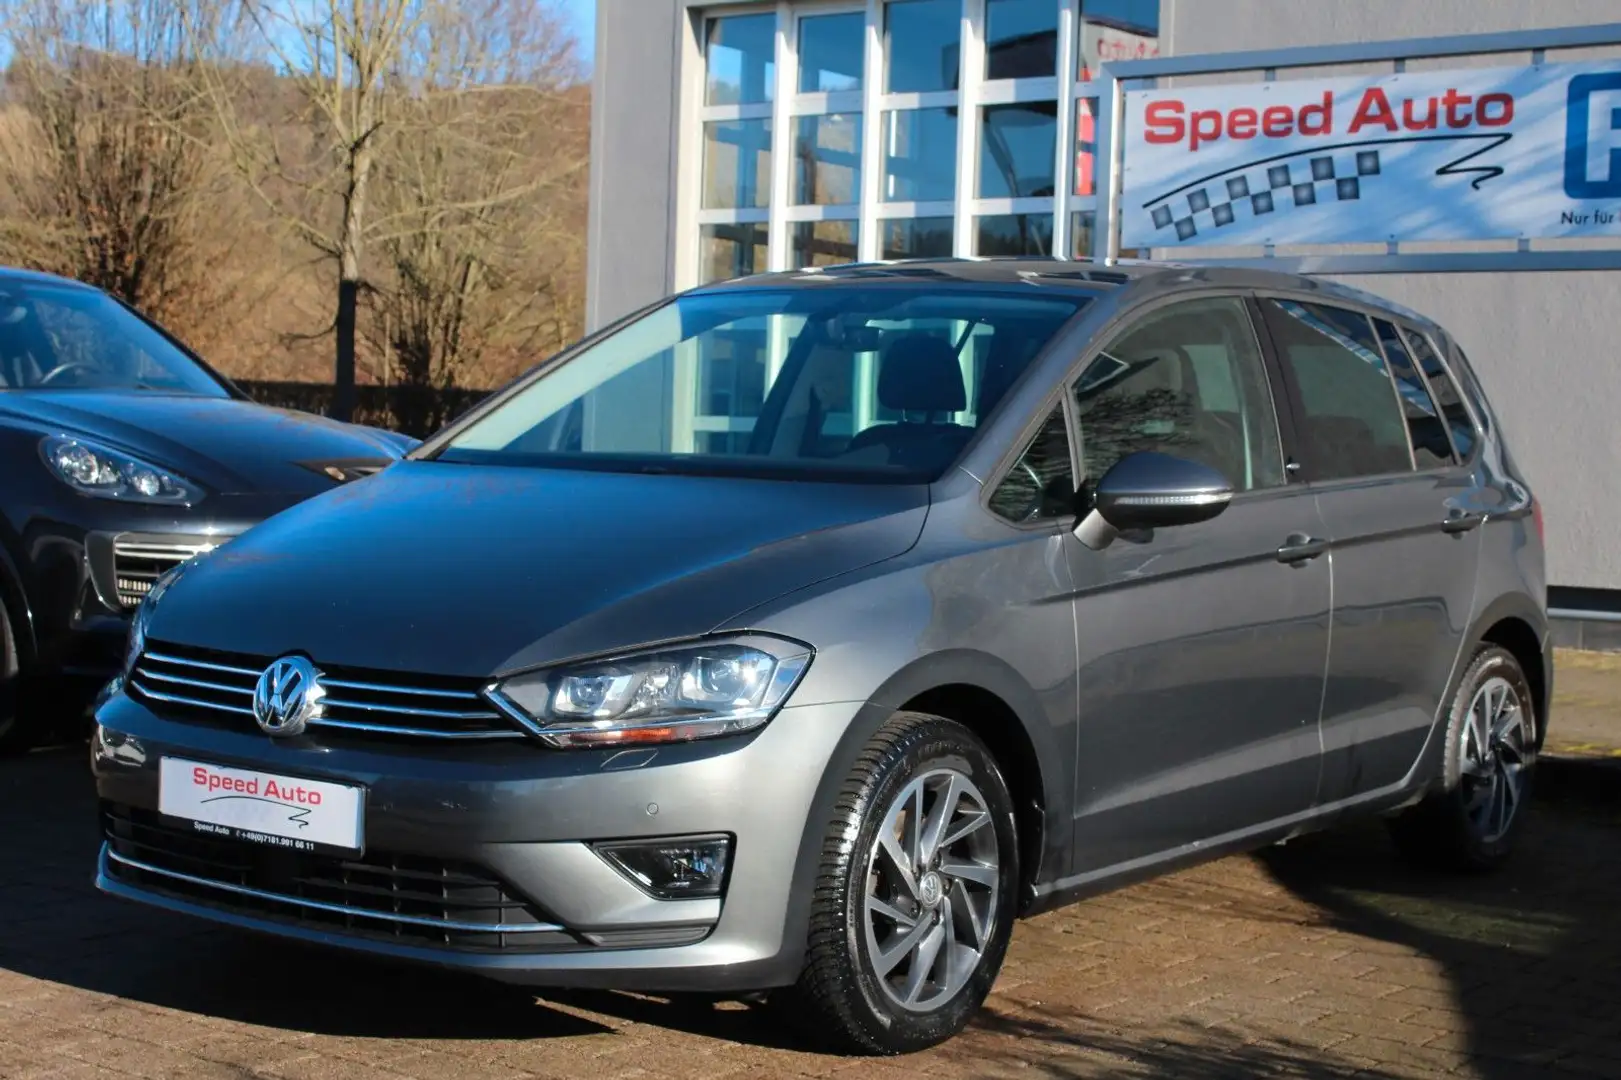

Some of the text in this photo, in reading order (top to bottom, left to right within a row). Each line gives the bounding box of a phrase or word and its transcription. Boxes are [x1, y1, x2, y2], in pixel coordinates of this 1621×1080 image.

[1144, 88, 1514, 151] Speed Auto
[1561, 212, 1589, 225] Nur
[1593, 209, 1614, 225] für
[193, 767, 321, 805] Speed Auto
[194, 821, 214, 833] Speed
[215, 826, 230, 836] Auto
